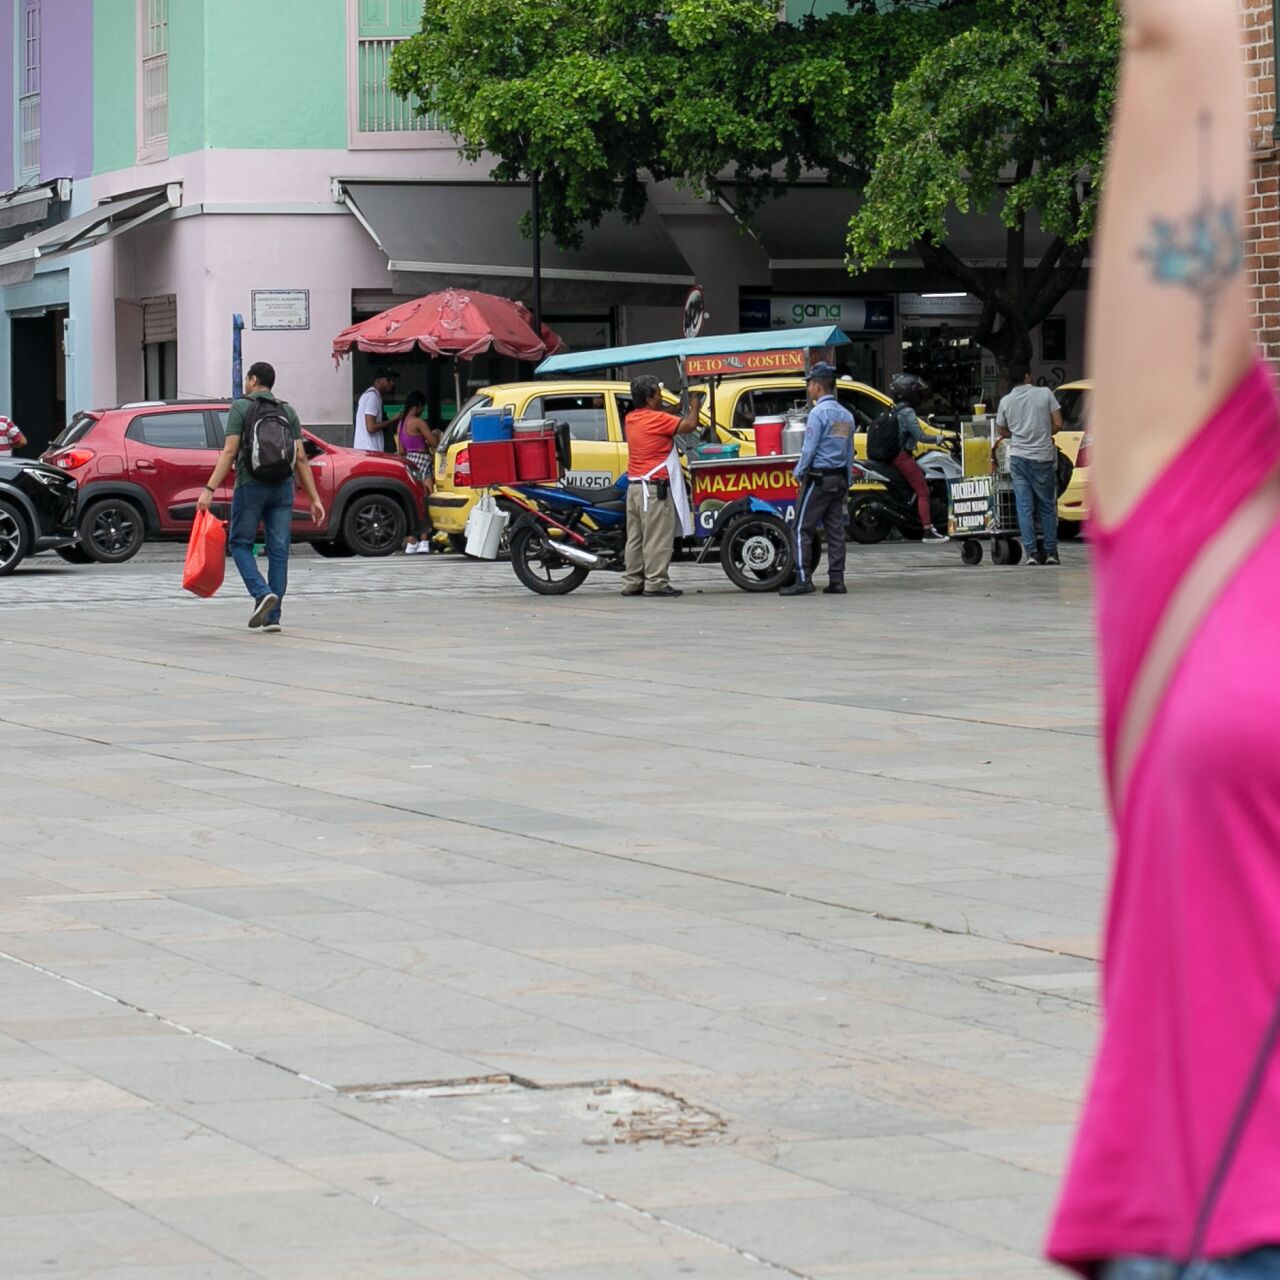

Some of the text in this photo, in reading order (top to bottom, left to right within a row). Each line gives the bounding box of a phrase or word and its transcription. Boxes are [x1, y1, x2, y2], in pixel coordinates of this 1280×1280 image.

[792, 303, 841, 323] gana
[688, 358, 721, 373] PETO
[695, 470, 802, 494] MAZAMOR
[950, 480, 990, 500] MICHELADA
